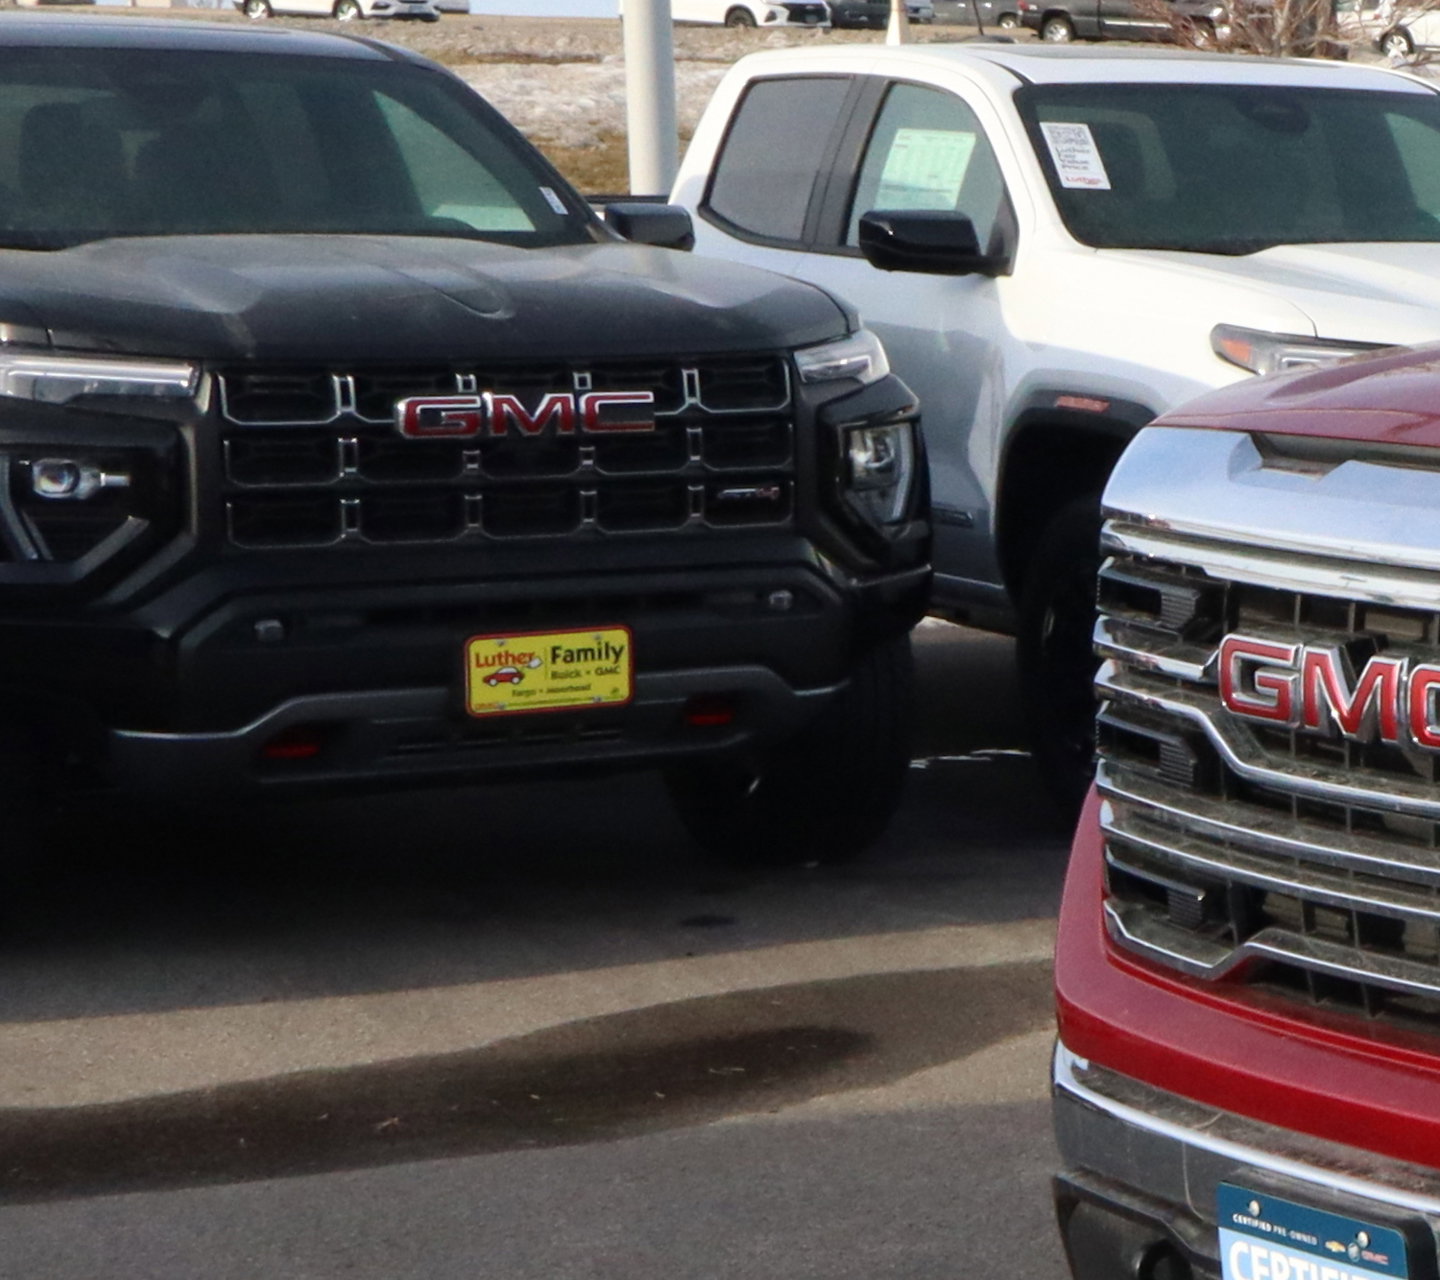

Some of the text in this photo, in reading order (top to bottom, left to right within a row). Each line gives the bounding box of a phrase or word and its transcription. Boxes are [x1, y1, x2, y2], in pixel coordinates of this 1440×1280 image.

[396, 391, 655, 438] GMC
[474, 650, 536, 668] Luther
[551, 641, 625, 665] Family
[1232, 1213, 1273, 1233] CERTIFIED
